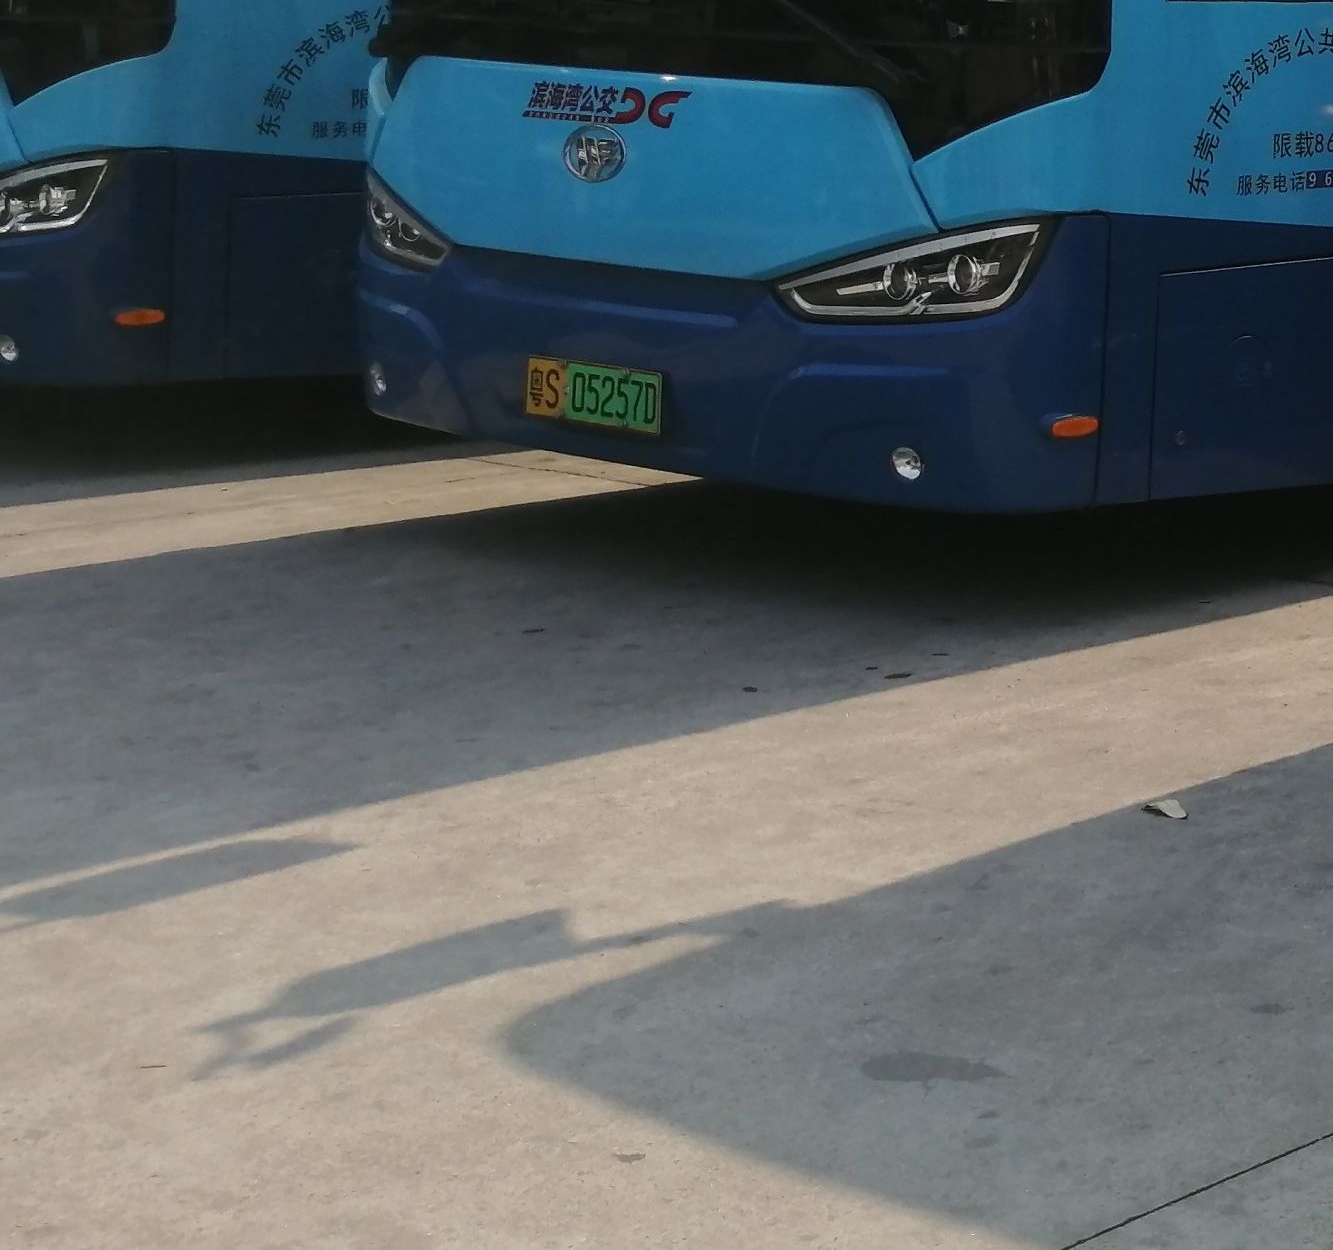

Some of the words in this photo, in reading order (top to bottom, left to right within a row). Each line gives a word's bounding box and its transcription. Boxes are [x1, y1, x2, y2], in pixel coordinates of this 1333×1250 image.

[527, 80, 620, 116] 滨海湾公交
